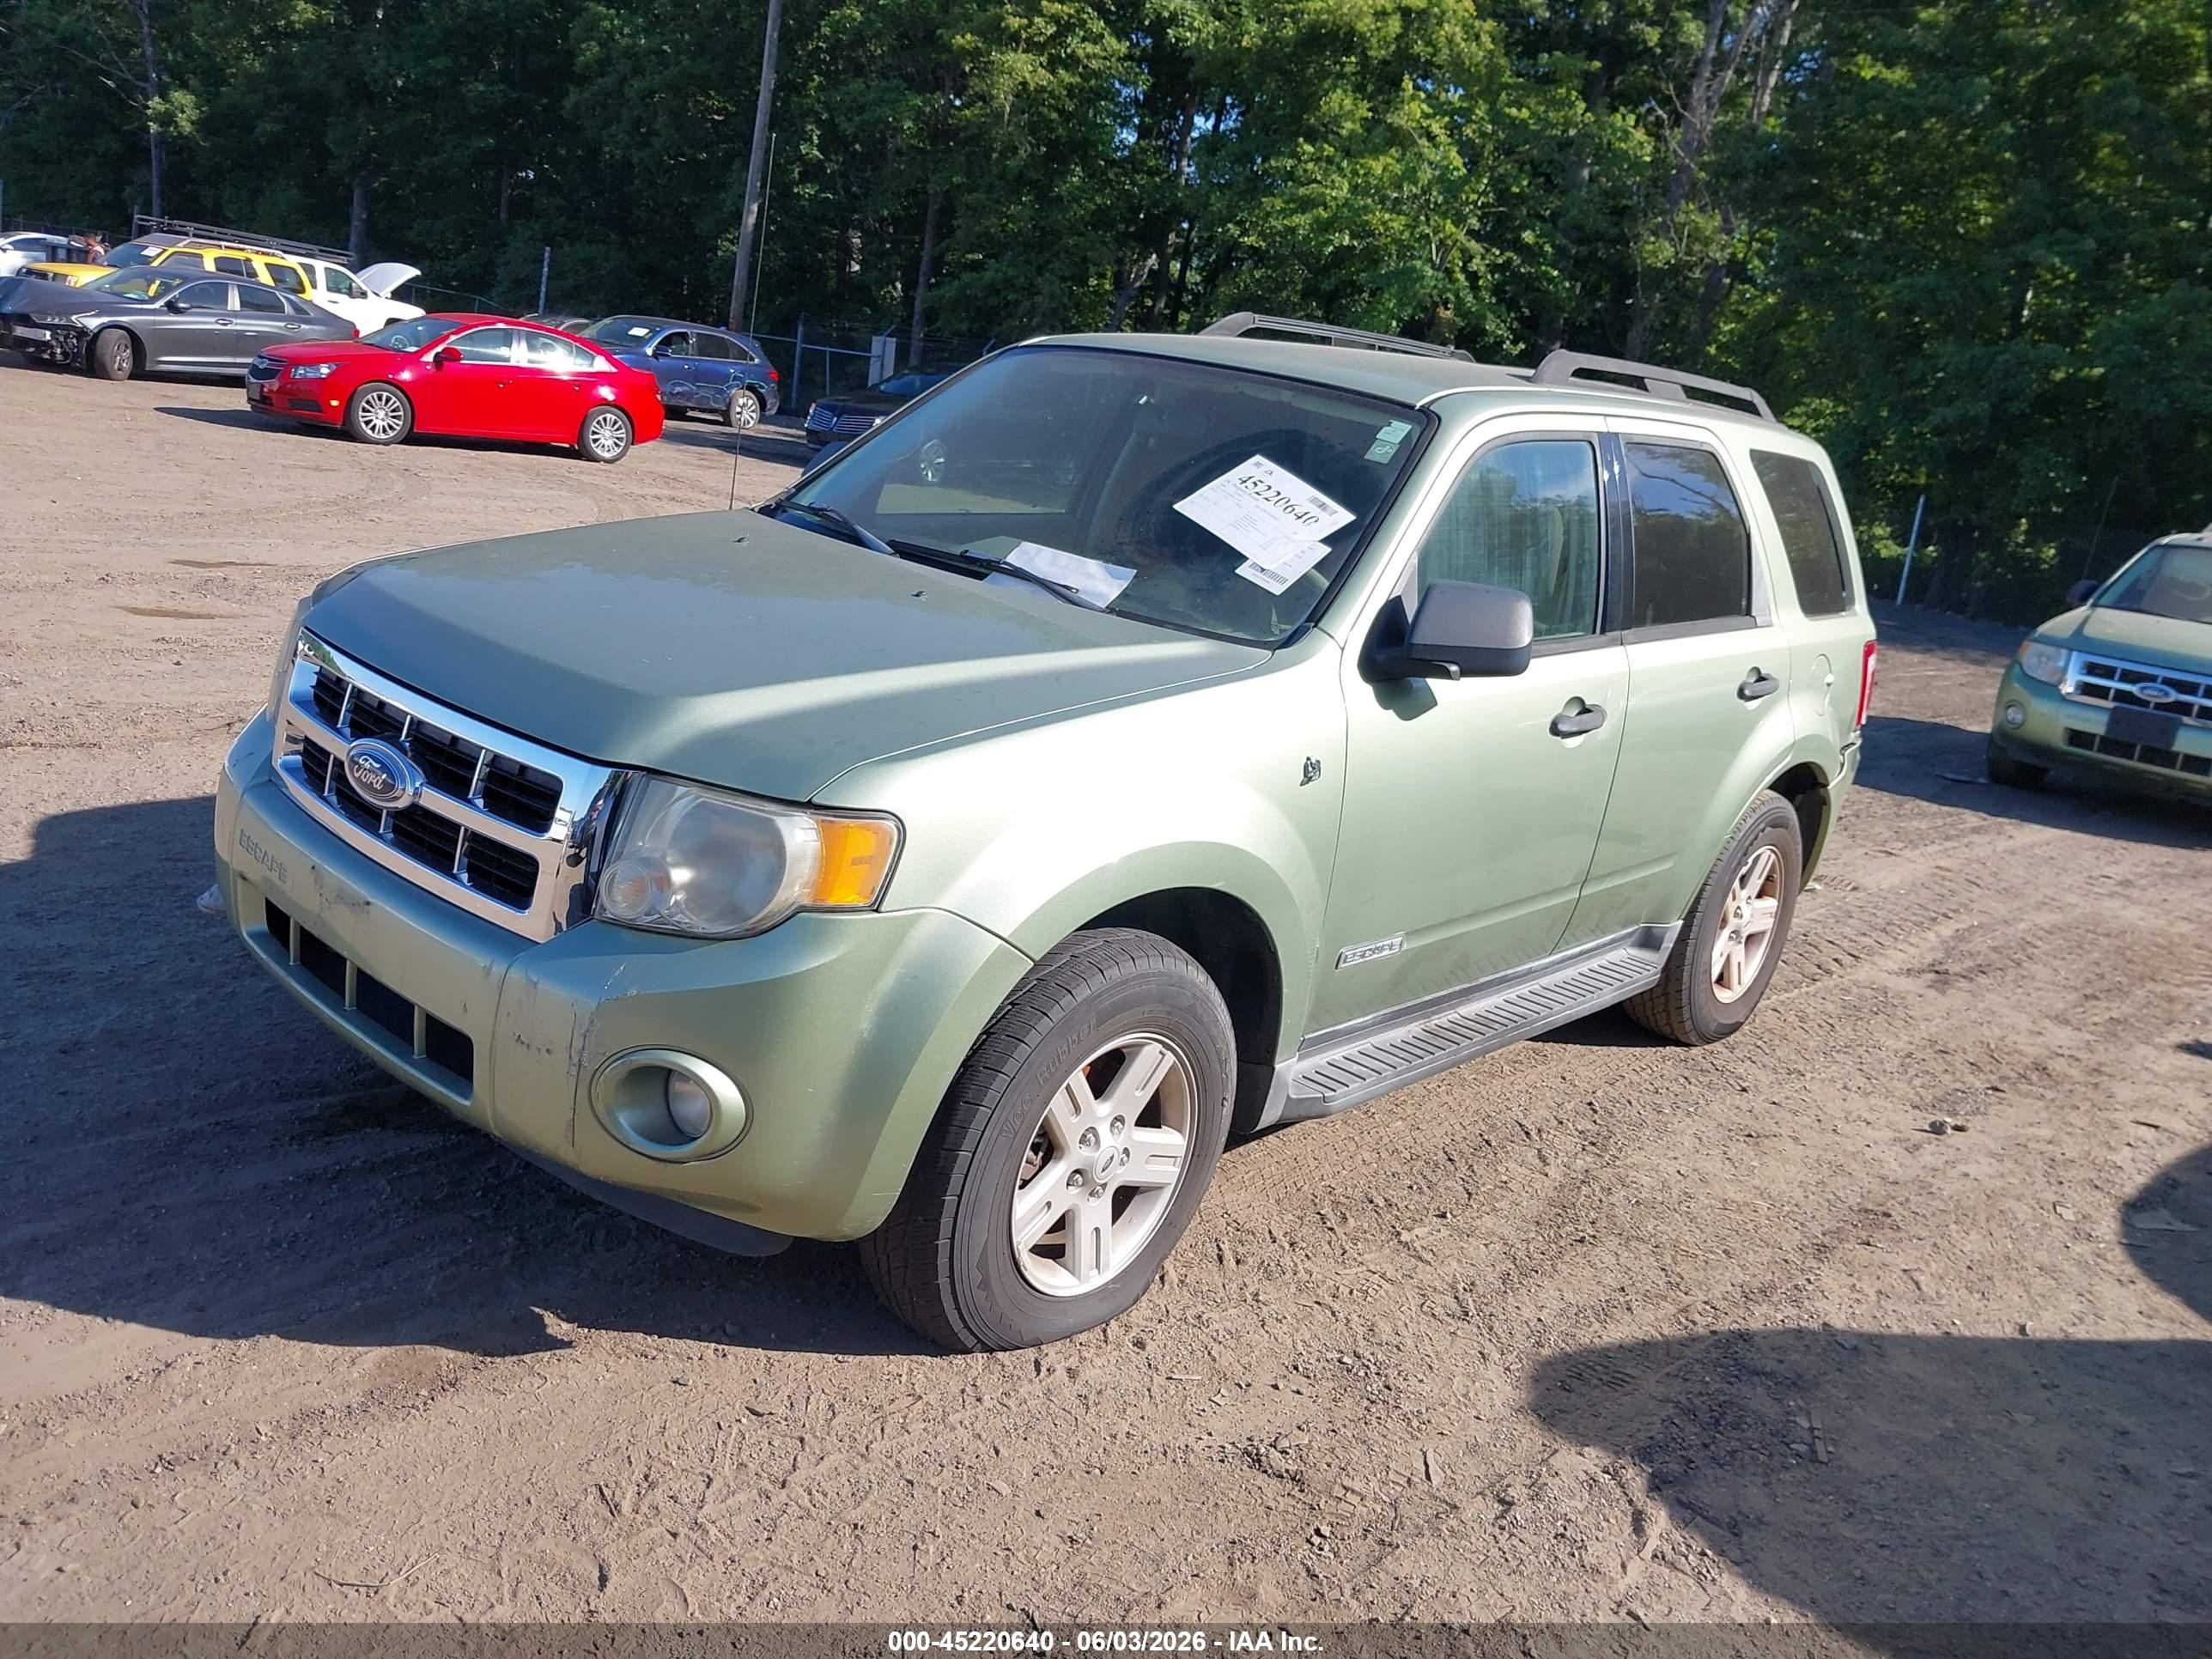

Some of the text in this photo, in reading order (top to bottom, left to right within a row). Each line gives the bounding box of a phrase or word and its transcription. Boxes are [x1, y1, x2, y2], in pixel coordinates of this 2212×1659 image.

[1237, 475, 1320, 527] 45220640
[353, 755, 382, 790] Ford
[239, 829, 289, 884] ESCAPE
[1342, 940, 1402, 964] ESCAPE
